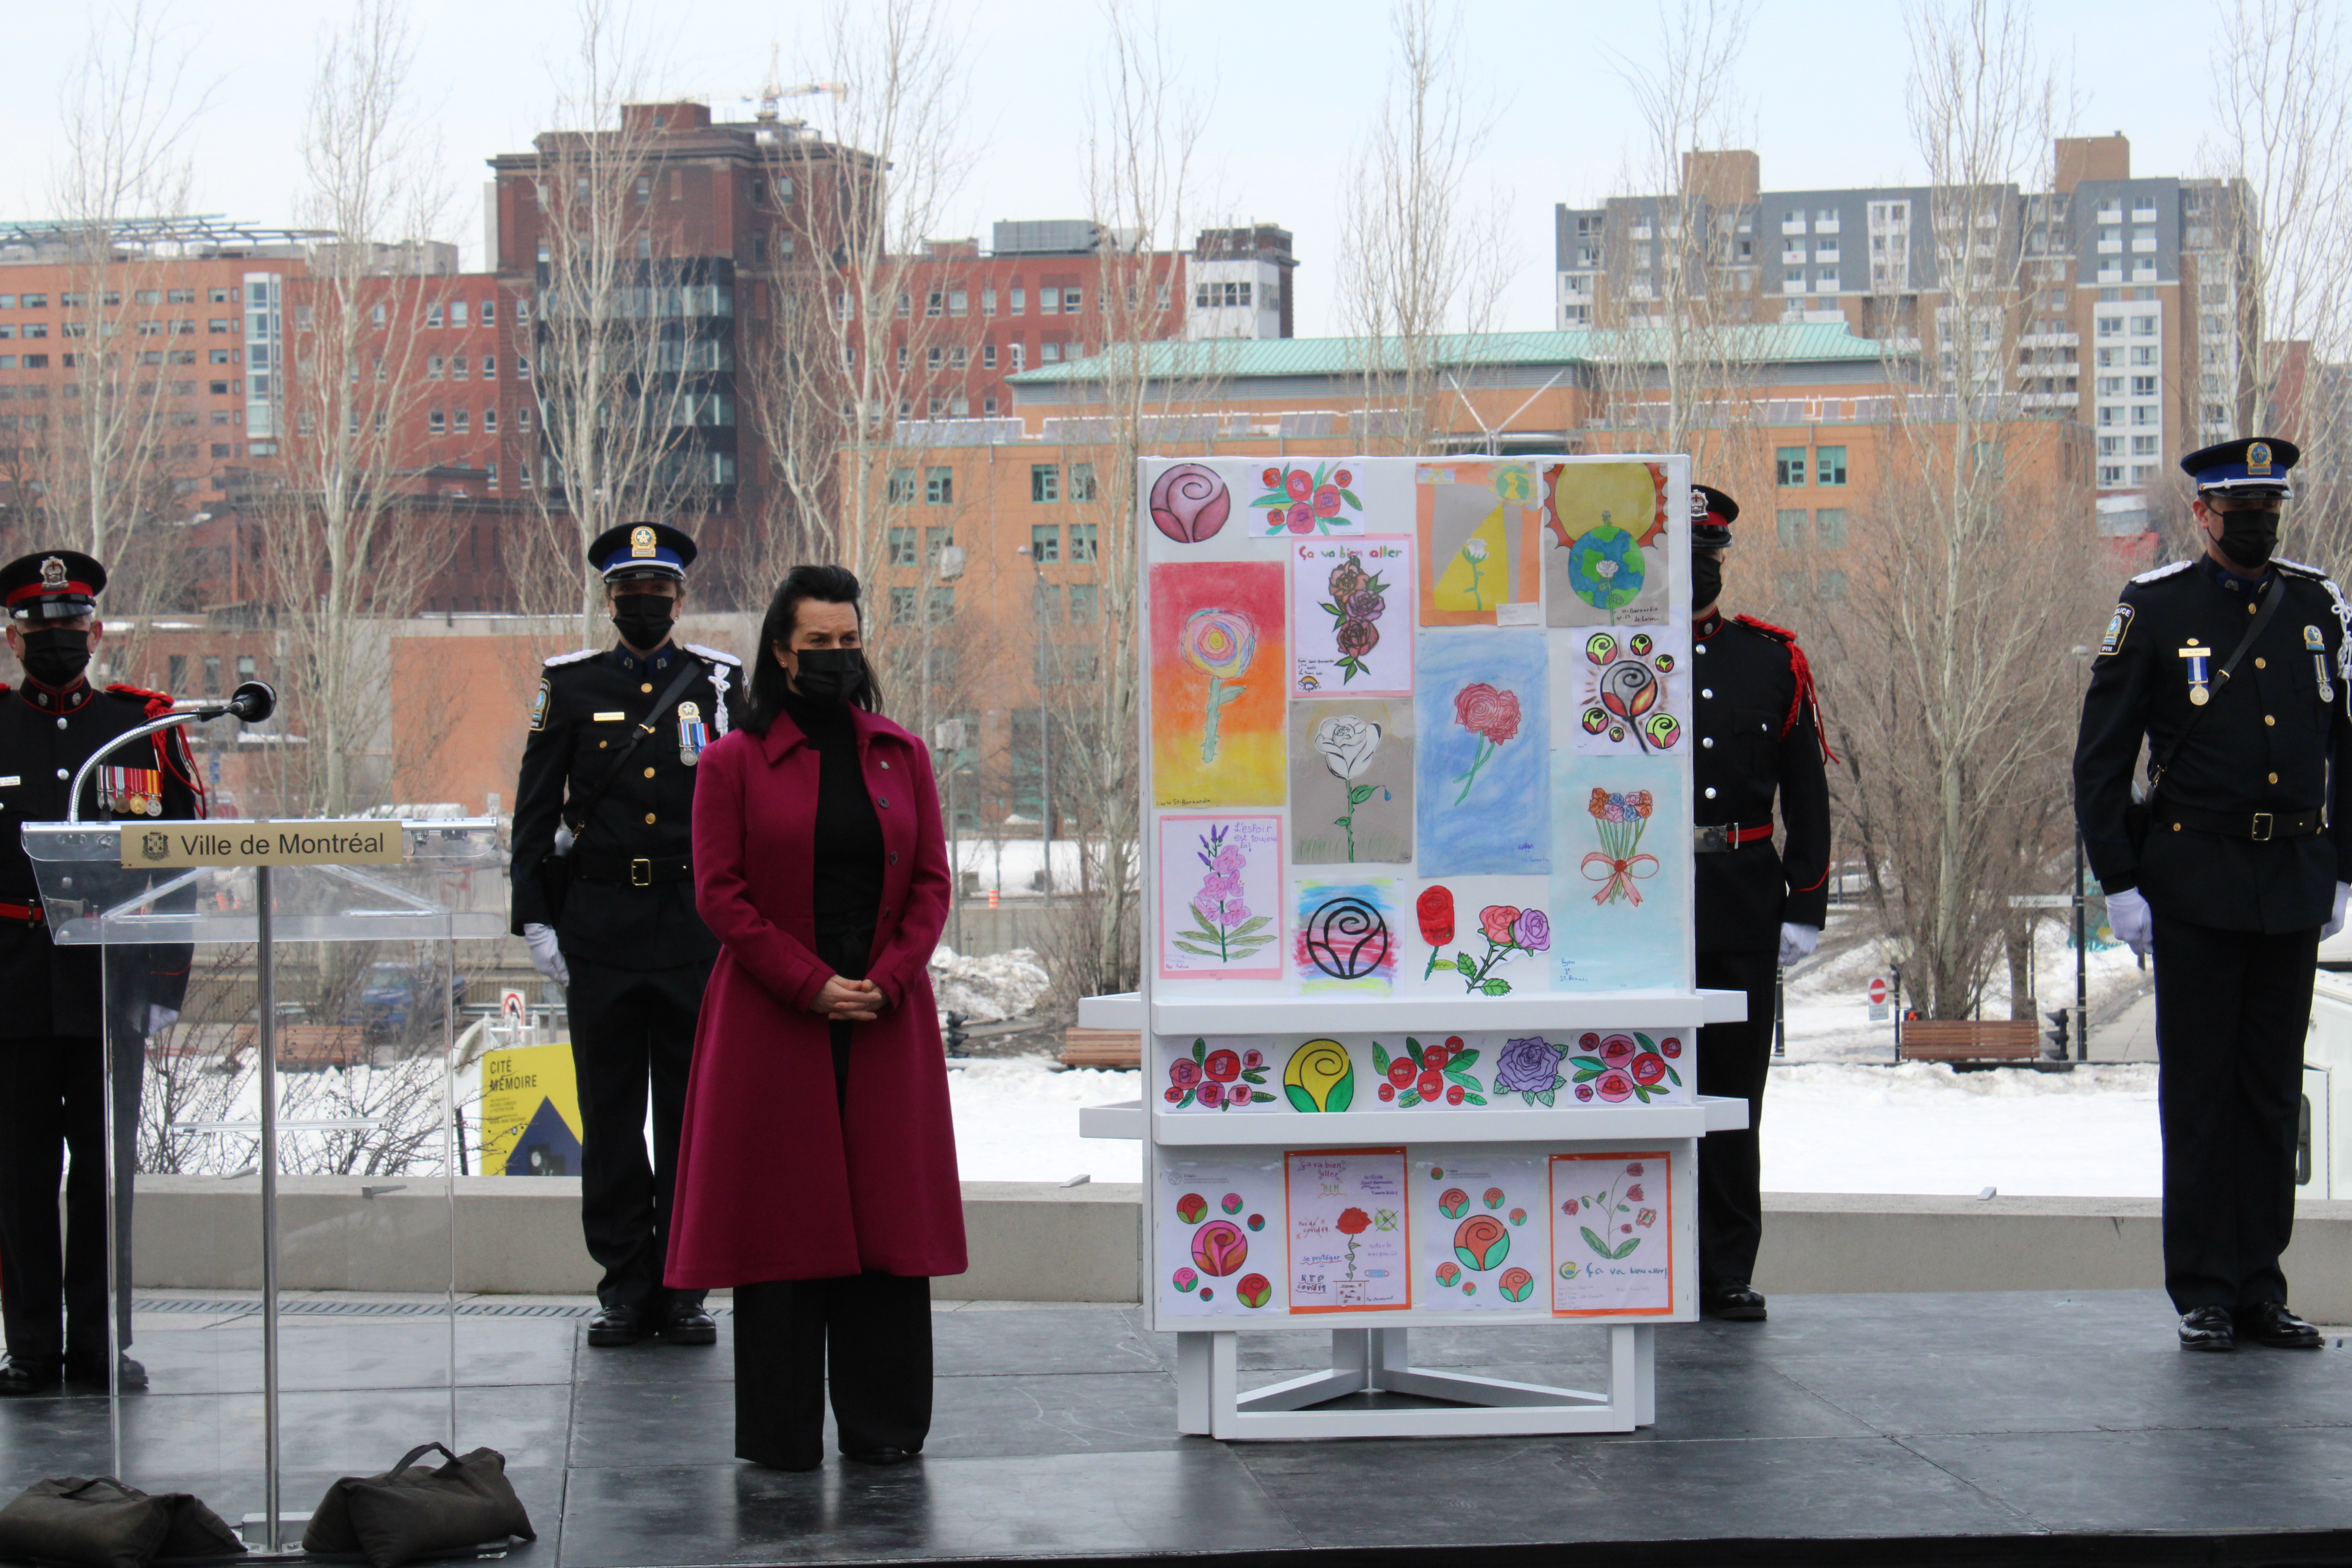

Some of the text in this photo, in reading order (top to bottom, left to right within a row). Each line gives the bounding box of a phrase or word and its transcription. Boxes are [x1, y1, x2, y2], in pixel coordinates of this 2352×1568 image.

[1299, 545, 1314, 560] Ça
[1339, 545, 1363, 558] bien
[1370, 545, 1402, 558] aller
[181, 832, 384, 855] Ville de Montréal
[490, 1056, 512, 1074] CITÉ
[490, 1074, 537, 1091] MÉMOIRE
[1301, 1161, 1312, 1171] Ça
[1325, 1160, 1341, 1169] bien
[1323, 1184, 1339, 1192] BLM
[1312, 1254, 1341, 1263] protéger
[1586, 1262, 1604, 1278] Ça
